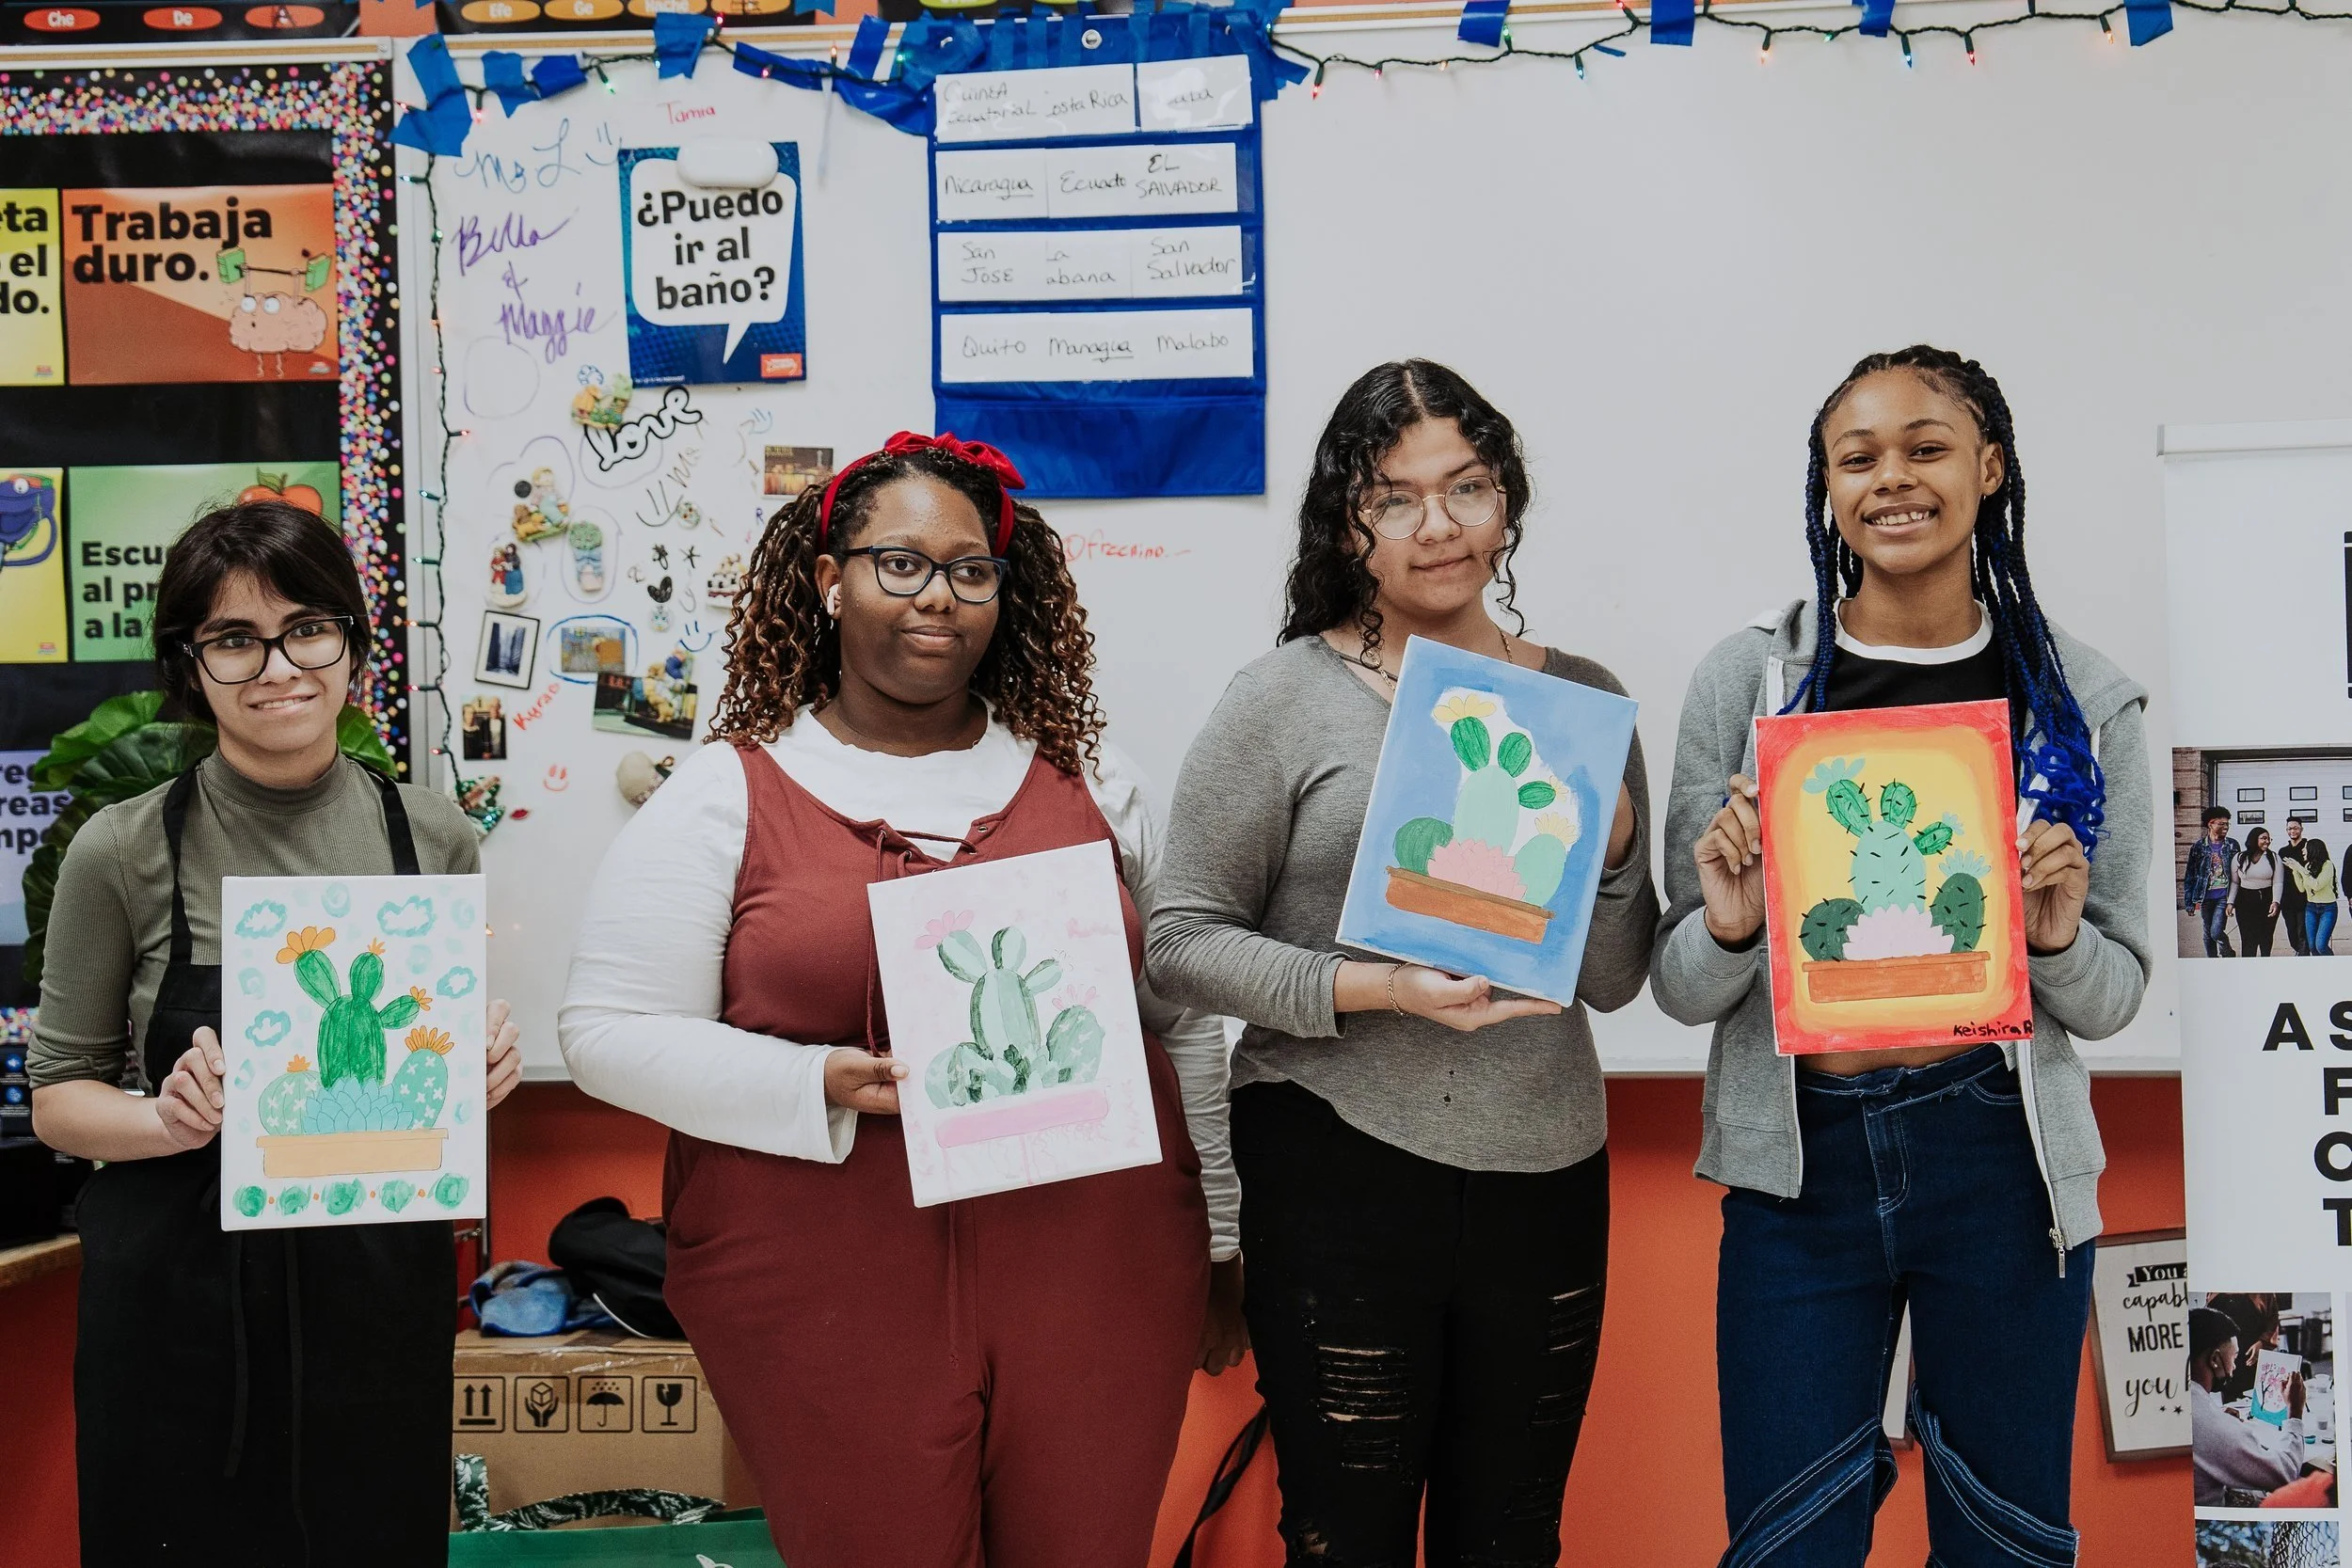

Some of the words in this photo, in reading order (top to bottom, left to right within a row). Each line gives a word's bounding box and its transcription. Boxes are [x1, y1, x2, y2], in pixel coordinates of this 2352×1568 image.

[48, 10, 75, 27] Che
[172, 10, 194, 25] De
[1089, 88, 1129, 109] Rica
[945, 175, 1034, 200] Nicaragua
[0, 199, 48, 232] ta
[638, 187, 783, 227] ¿Puedo
[72, 196, 272, 249] Trabaja
[675, 232, 704, 265] ir
[717, 227, 750, 261] al
[961, 241, 995, 261] San
[1151, 236, 1189, 256] San
[9, 243, 48, 277] el
[72, 244, 210, 283] duro.
[1146, 256, 1235, 279] Salvador
[656, 266, 775, 310] baño?
[962, 336, 1025, 357] Quito
[1049, 337, 1134, 362] Managua
[1157, 332, 1229, 353] Malabo
[83, 577, 113, 602] al
[85, 618, 103, 639] a
[114, 612, 142, 638] la
[1953, 1021, 2021, 1037] Keishira
[2142, 1266, 2178, 1281] You
[2127, 1323, 2184, 1353] MORE
[2124, 1376, 2178, 1418] you
